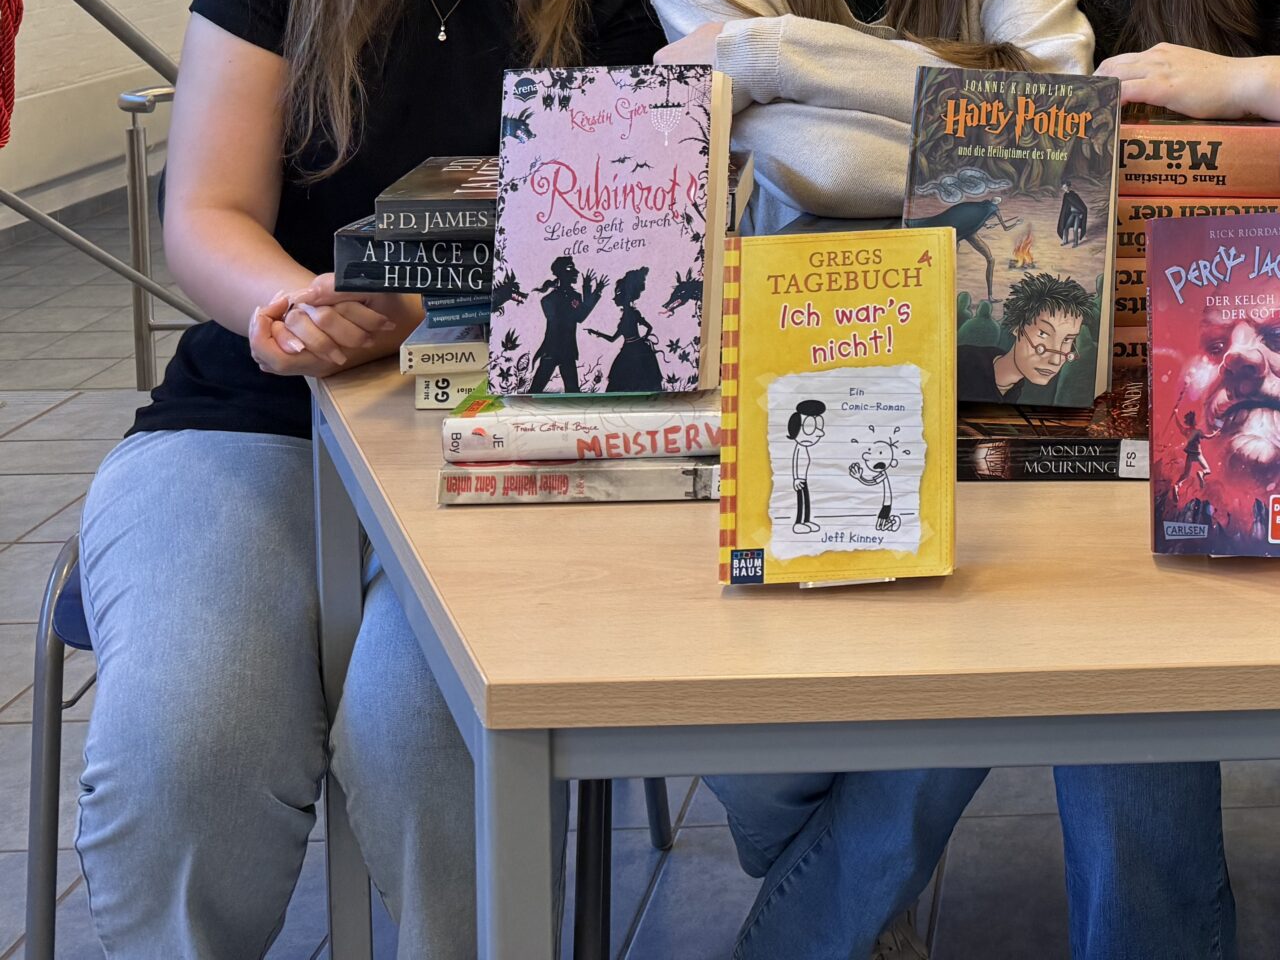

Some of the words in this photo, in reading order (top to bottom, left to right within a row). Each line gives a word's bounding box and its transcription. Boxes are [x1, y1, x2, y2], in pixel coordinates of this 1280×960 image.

[512, 84, 539, 95] Arena
[963, 79, 1005, 94] JOANNE
[1010, 83, 1021, 95] K.
[1025, 83, 1074, 97] ROWLING
[569, 108, 613, 132] Kirstin
[615, 97, 649, 140] Gier
[941, 97, 1014, 138] Harry
[1014, 96, 1093, 145] Potter
[958, 146, 973, 156] und
[974, 146, 986, 157] die
[987, 145, 1030, 160] Heiligtümer
[1032, 149, 1044, 160] des
[1046, 149, 1068, 161] Todes
[530, 153, 681, 223] Rubinrot
[1125, 173, 1188, 185] Christian
[1192, 174, 1227, 185] Hans
[422, 211, 488, 234] JAMES
[544, 221, 587, 241] Liebe
[593, 217, 624, 240] geht
[632, 213, 671, 230] durch
[1209, 230, 1235, 239] RICK
[362, 241, 377, 262] A
[384, 241, 463, 264] PLACE
[563, 241, 589, 256] alle
[597, 236, 646, 254] Zeiten
[809, 249, 883, 268] GREGS
[917, 249, 933, 267] 4
[384, 266, 484, 289] HIDING
[767, 267, 923, 295] TAGEBUCH
[1164, 245, 1246, 305] PERCY
[1206, 296, 1231, 306] DER
[1234, 294, 1275, 305] KELCH
[779, 301, 822, 330] Ich
[834, 297, 912, 325] war's
[1222, 309, 1246, 320] DER
[811, 325, 894, 365] nicht!
[420, 351, 476, 365] Wickie
[434, 377, 450, 403] GG
[849, 388, 865, 396] Ein
[1120, 381, 1144, 417] MONDAY
[841, 401, 905, 412] Comic-Roman
[512, 421, 537, 433] Frank
[539, 421, 569, 433] Cottrell
[572, 422, 599, 433] Boyce
[450, 432, 462, 454] Boy
[492, 434, 504, 449] JE
[1039, 445, 1103, 457] MONDAY
[1126, 451, 1137, 468] FS
[1023, 460, 1117, 474] MOURNING
[474, 475, 497, 496] Ganz
[502, 474, 537, 496] Wallraff
[537, 474, 569, 496] Günter
[821, 533, 845, 543] Jeff
[849, 533, 884, 545] Kinney
[1166, 525, 1206, 536] CARLSEN
[733, 559, 762, 567] BAUM
[733, 567, 762, 576] HAUS
